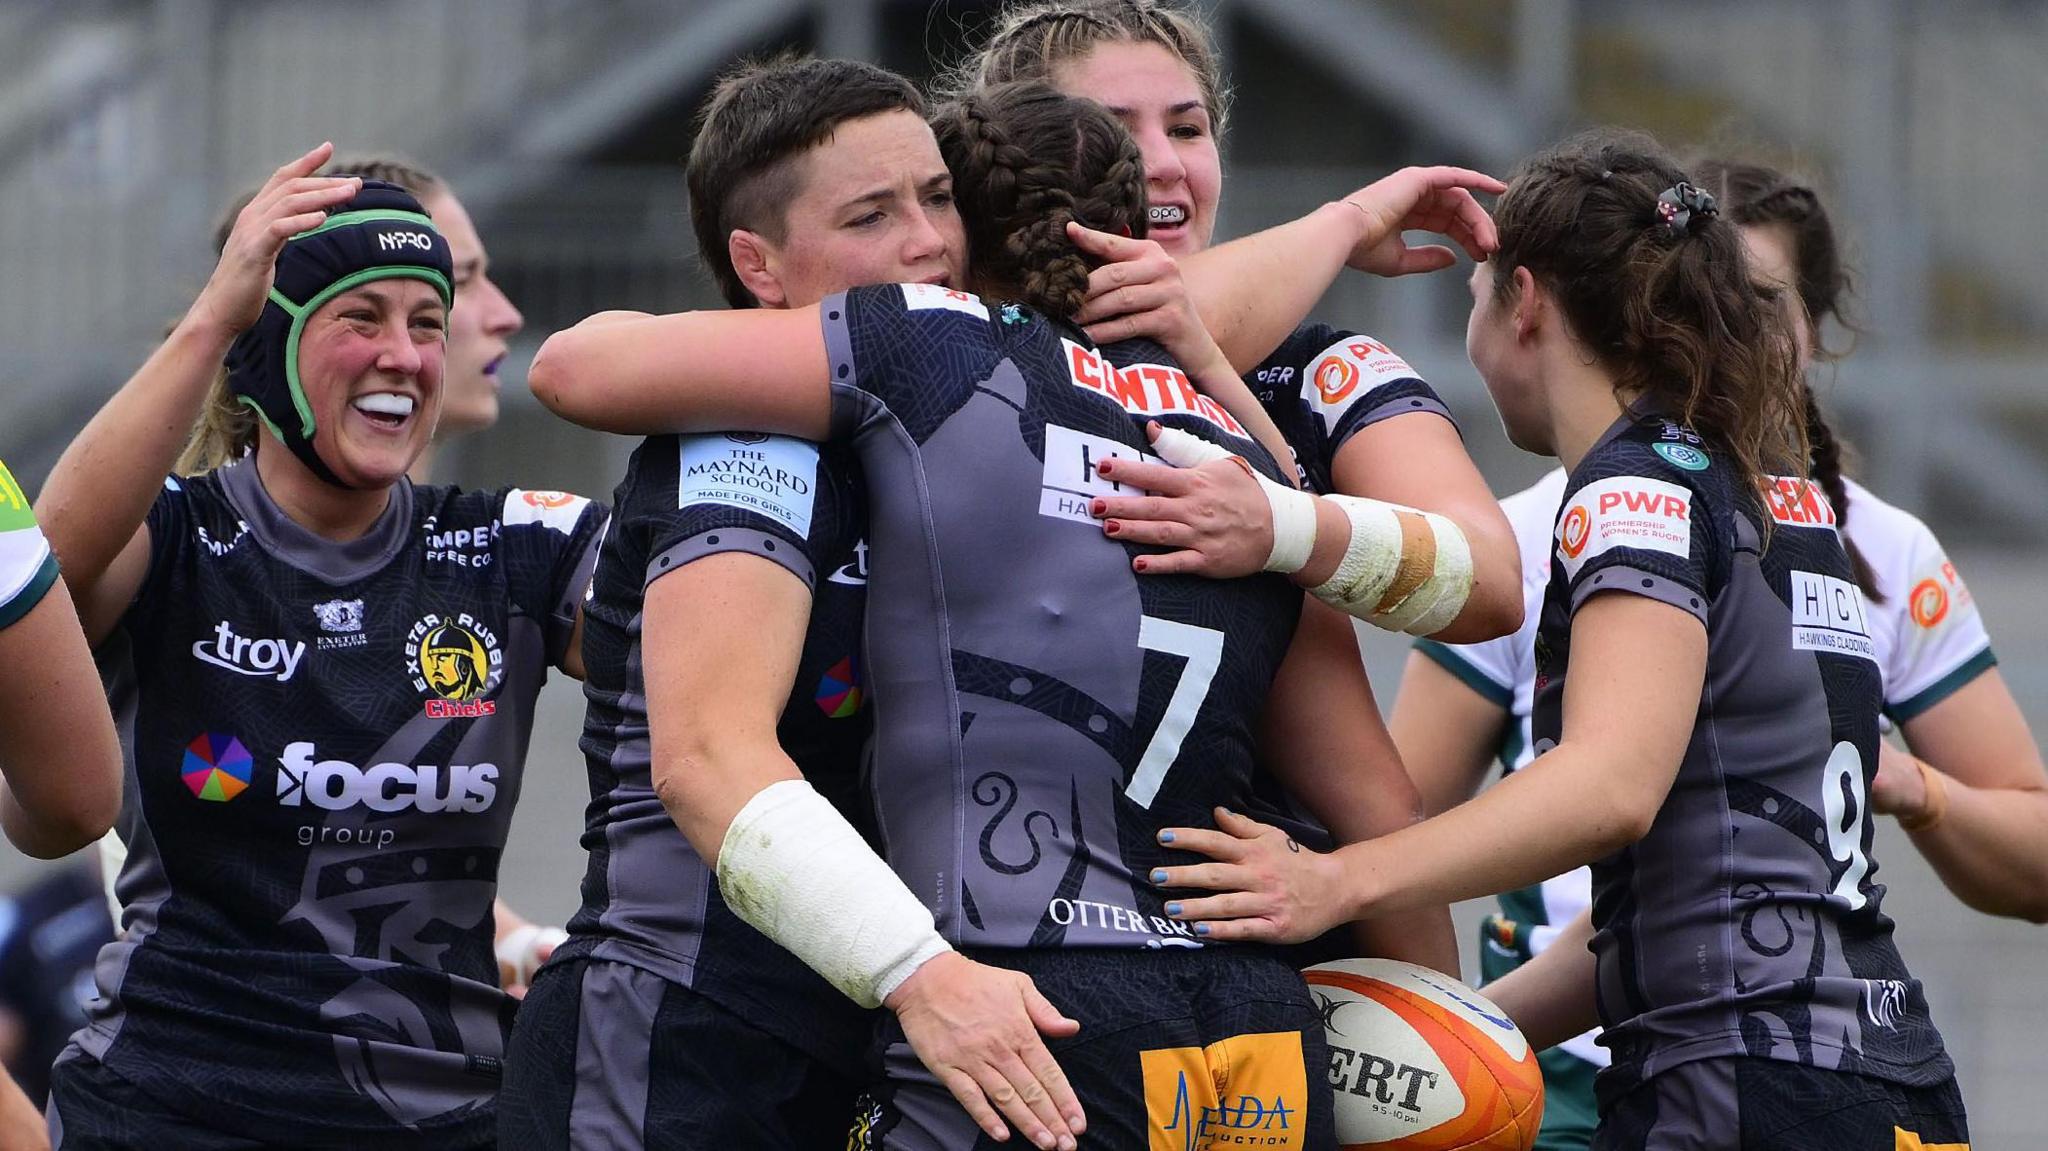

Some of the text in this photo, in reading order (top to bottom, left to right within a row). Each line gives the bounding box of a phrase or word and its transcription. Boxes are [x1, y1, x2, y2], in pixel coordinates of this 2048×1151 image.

[729, 450, 765, 462] THE
[687, 460, 808, 495] MAYNARD
[711, 473, 783, 497] SCHOOL
[698, 491, 792, 520] MADE FOR GIRLS
[1600, 491, 1686, 520] PWR
[1600, 520, 1666, 530] PREMIERSHIP
[1602, 528, 1685, 544] WOMEN'S RUGBY
[426, 550, 467, 567] FFEE
[214, 620, 306, 681] troy
[405, 612, 503, 693] EXETER RUGBY
[1799, 631, 1836, 649] HAWKINGS
[424, 698, 497, 718] Chiefs
[1125, 614, 1225, 810] 7
[276, 741, 500, 814] focus
[297, 824, 395, 849] group
[1822, 740, 1869, 911] 9
[1049, 898, 1151, 934] OTTER
[1327, 1044, 1440, 1113] ERT
[1220, 1133, 1288, 1146] UCTION
